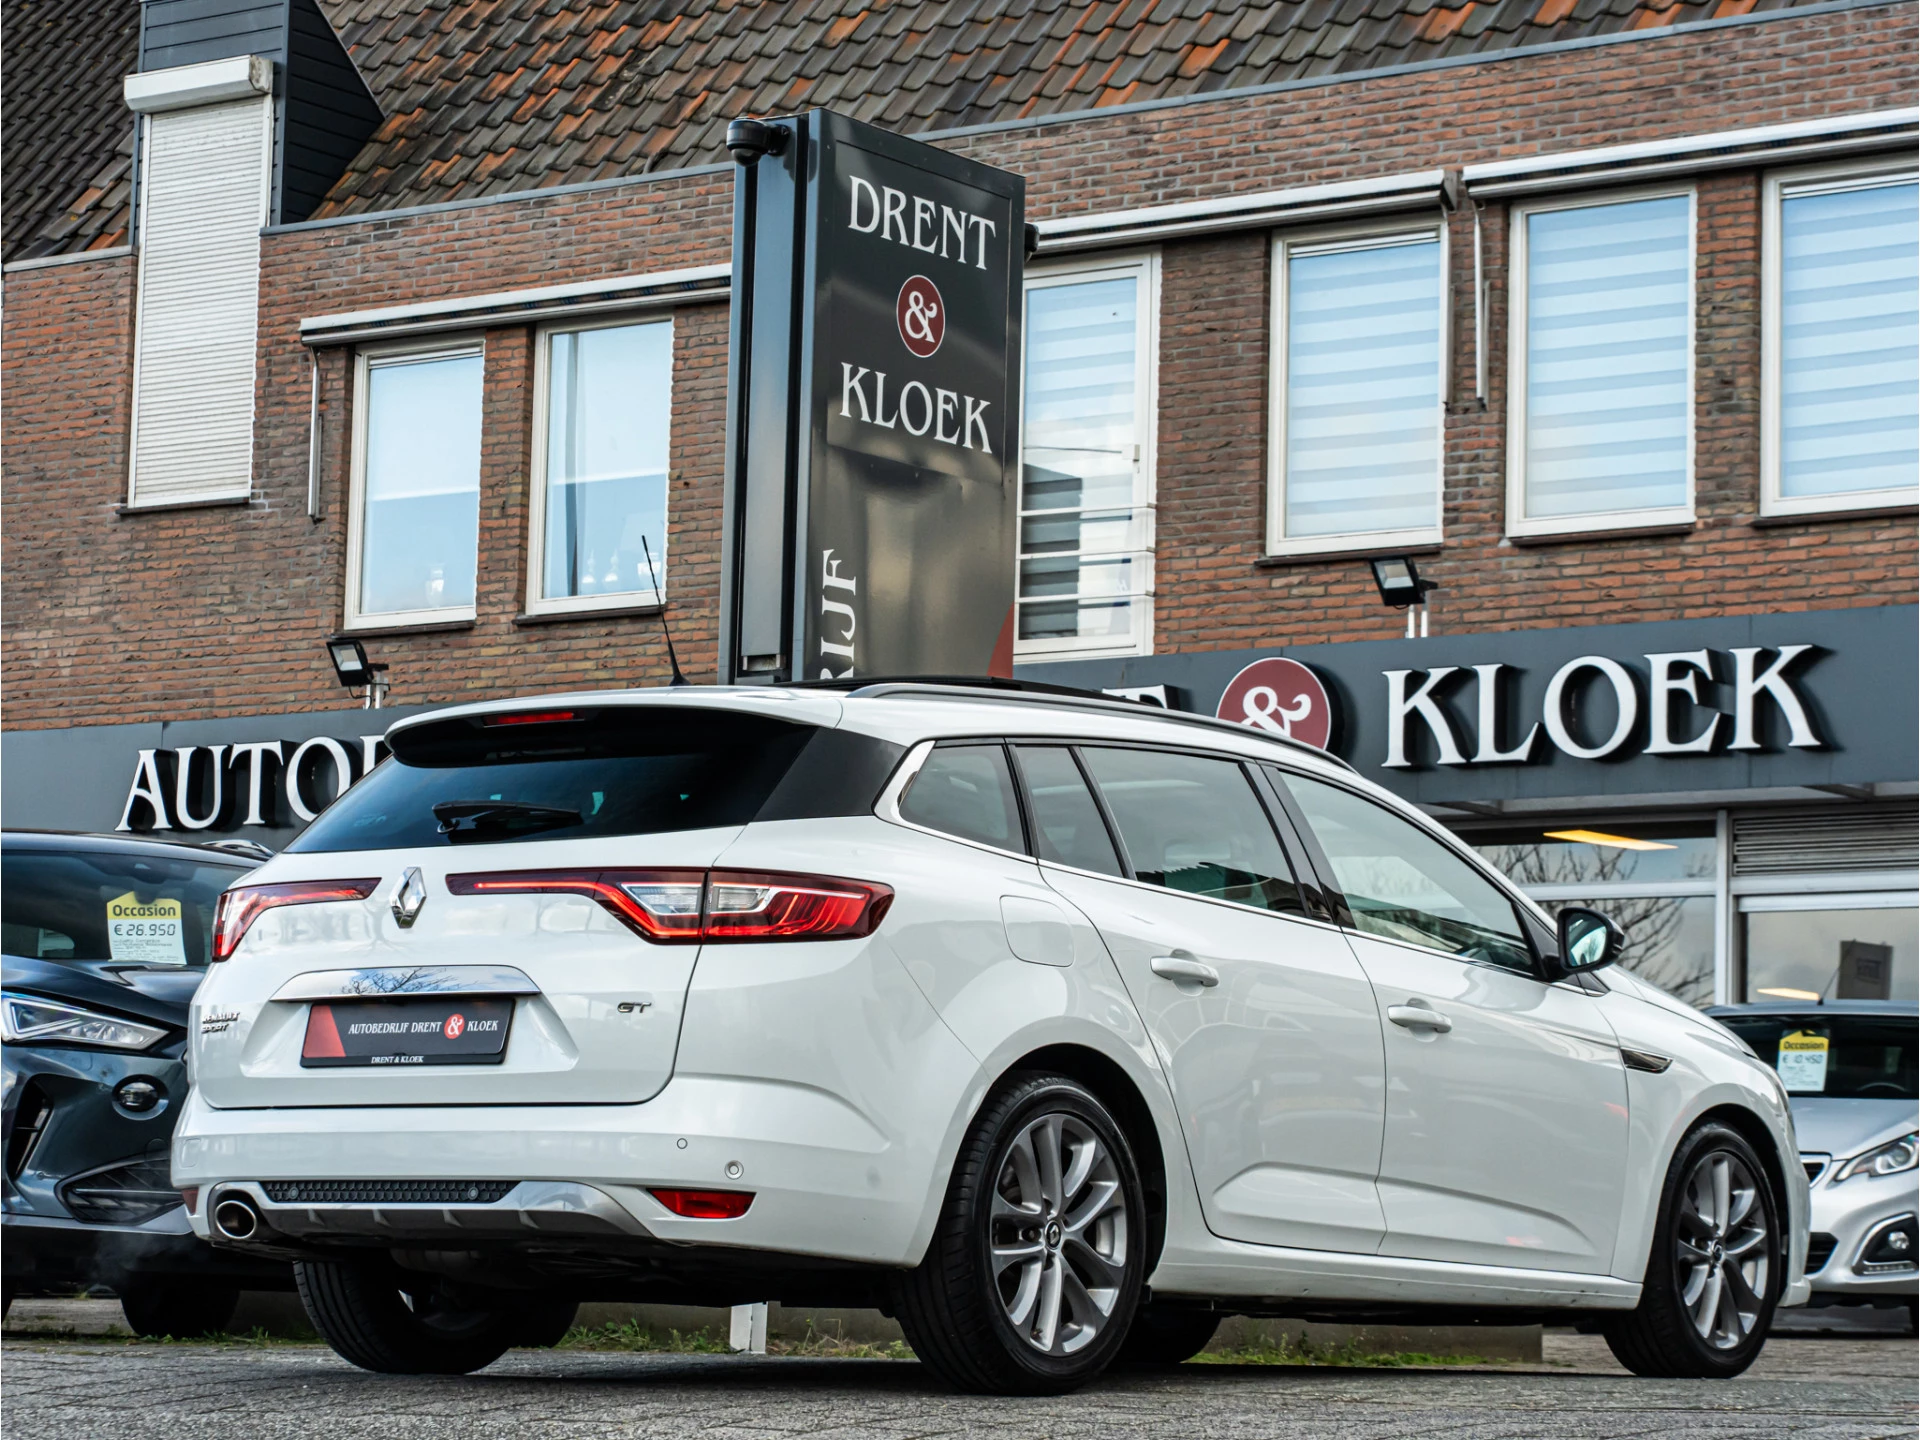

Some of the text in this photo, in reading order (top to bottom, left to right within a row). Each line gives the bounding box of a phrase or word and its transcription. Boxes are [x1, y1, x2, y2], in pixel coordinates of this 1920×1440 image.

[848, 175, 996, 270] DRENT
[904, 291, 938, 343] &
[839, 362, 992, 454] KLOEK
[1381, 644, 1821, 767] KLOEK
[112, 904, 176, 917] Occasion
[617, 1001, 652, 1014] GT
[348, 1016, 499, 1035] AUTOBEDRIJF DRENT & KLOEK
[1783, 1041, 1825, 1050] Occasion
[371, 1056, 394, 1064] DRENT
[394, 1056, 400, 1064] &
